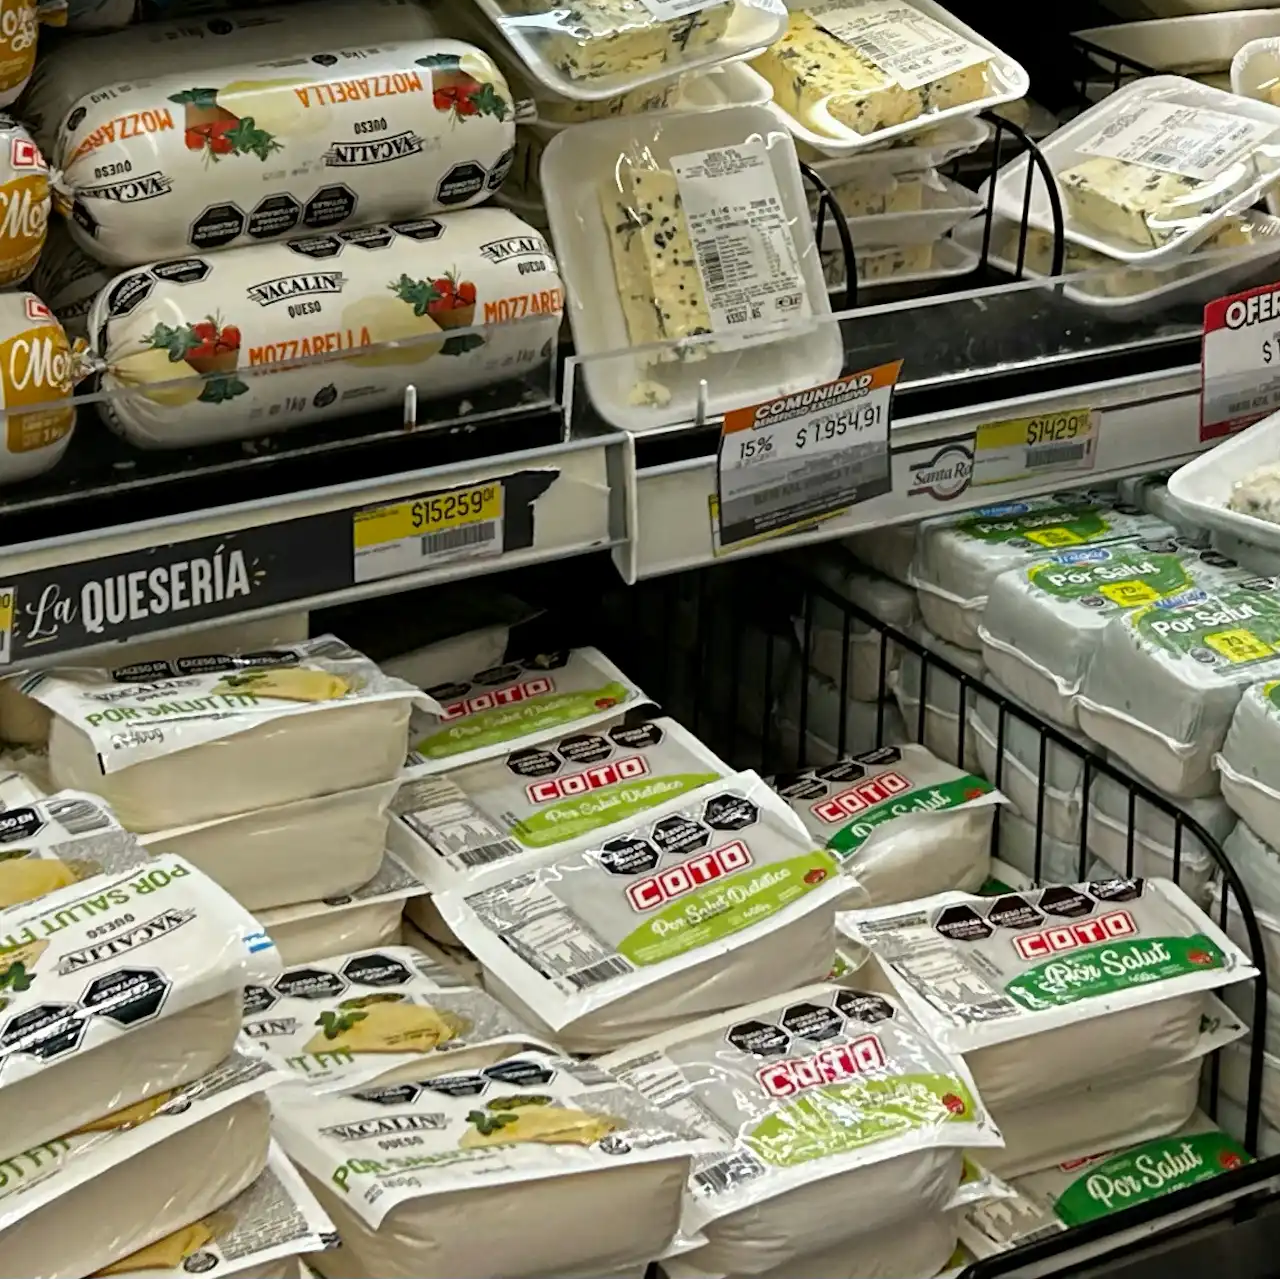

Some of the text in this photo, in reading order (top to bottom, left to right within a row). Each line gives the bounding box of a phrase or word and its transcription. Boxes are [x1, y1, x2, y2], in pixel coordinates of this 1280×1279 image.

[294, 70, 424, 109] MOZZARELLA
[353, 118, 388, 135] QUESO
[337, 132, 416, 165] VACALIN
[257, 272, 342, 303] VACALIN
[288, 301, 322, 318] QUESO
[249, 327, 373, 376] MOZZARELLA
[755, 374, 873, 419] COMUNIDAD
[740, 434, 774, 459] 15%
[913, 467, 952, 487] Santa
[1049, 558, 1160, 587] Por Salut
[27, 546, 251, 640] La QUESERÍA
[1151, 603, 1261, 637] Por Salut
[85, 706, 138, 727] POR
[441, 677, 553, 721] COTO
[527, 756, 649, 803] COTO
[811, 772, 912, 823] COTO
[628, 841, 752, 911] COTO
[36, 864, 191, 939] POR SALUT
[70, 911, 182, 968] VACALIN
[1015, 910, 1138, 960] COTO
[1101, 942, 1171, 976] Salut
[334, 1114, 438, 1140] VACALIN
[1086, 1147, 1203, 1208] Por Salut
